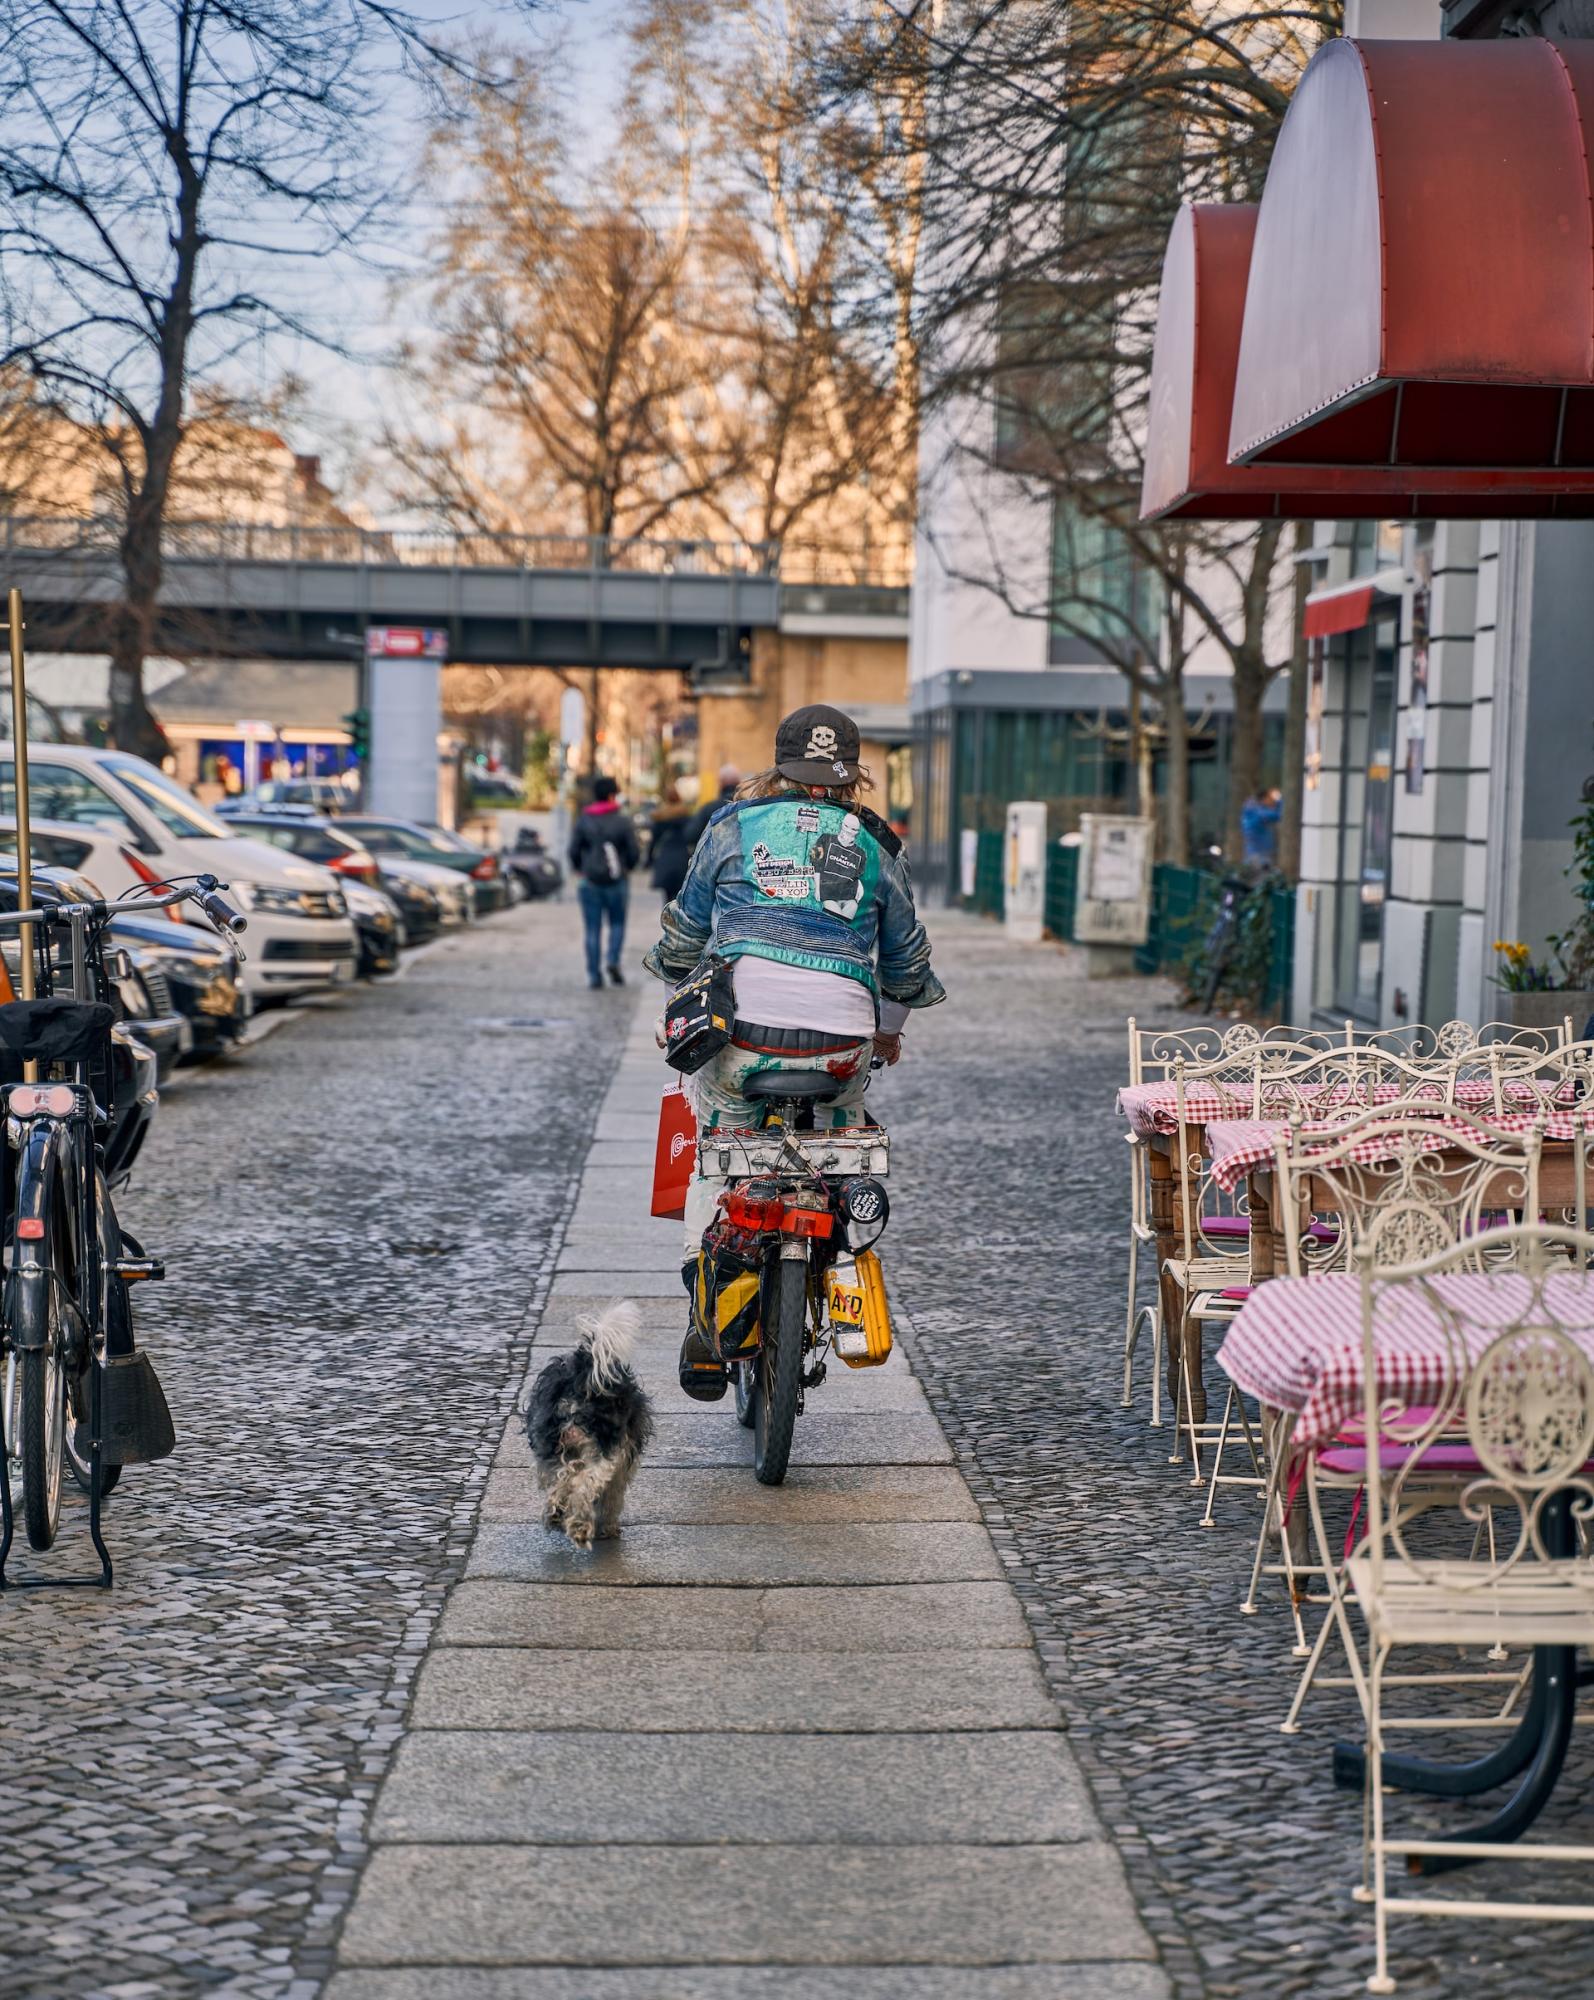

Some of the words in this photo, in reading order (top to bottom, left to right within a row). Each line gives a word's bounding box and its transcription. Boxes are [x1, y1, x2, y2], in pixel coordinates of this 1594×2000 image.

[830, 855, 857, 869] CHANTAL
[787, 888, 808, 896] YOU
[831, 1293, 863, 1314] AfD
